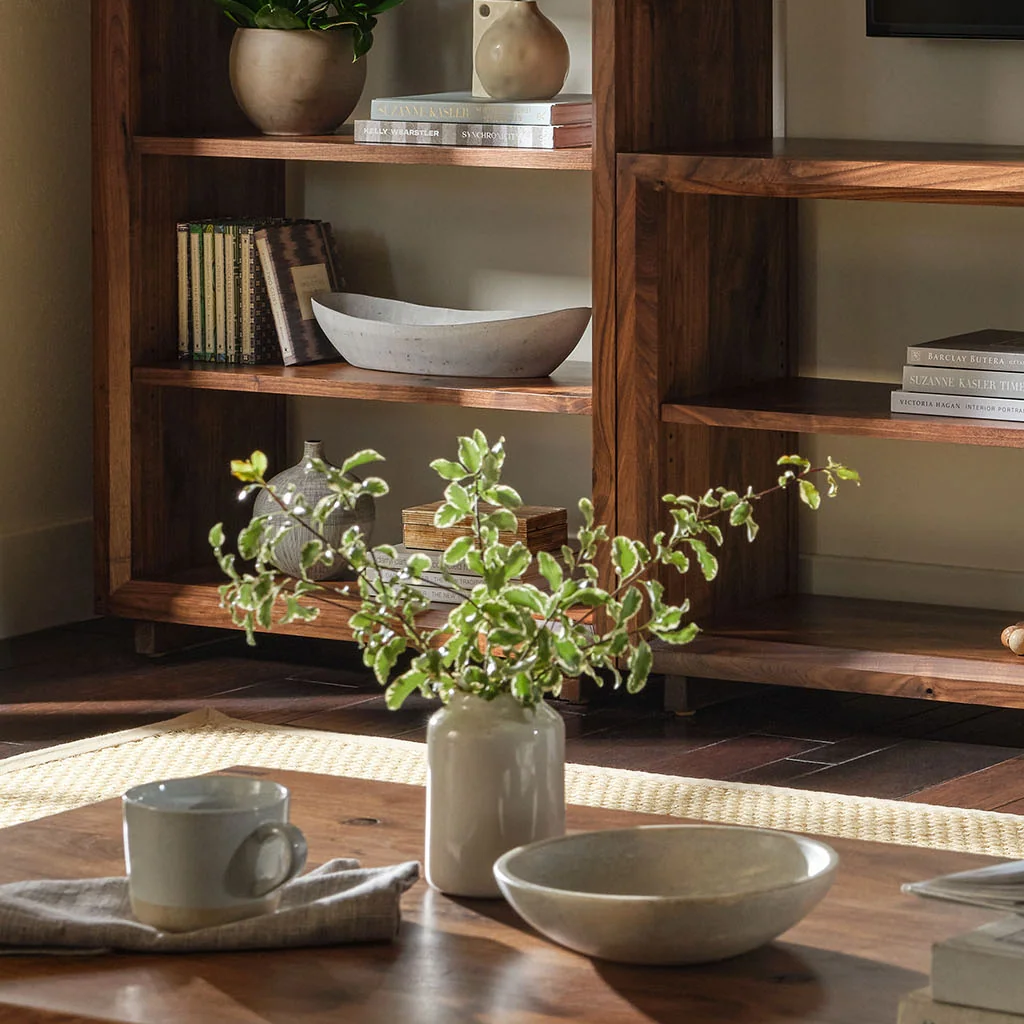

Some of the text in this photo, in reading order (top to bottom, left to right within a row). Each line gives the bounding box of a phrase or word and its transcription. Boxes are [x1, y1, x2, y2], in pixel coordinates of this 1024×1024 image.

[363, 127, 440, 138] KELLY WEARSTLER
[928, 352, 968, 363] BARCLAY
[969, 354, 1005, 366] BUTERA
[909, 375, 954, 389] SUZANNE
[958, 377, 996, 391] KASLER
[899, 398, 934, 410] VICTORIA
[935, 401, 961, 410] HAGAN
[964, 403, 996, 412] INTERIOR
